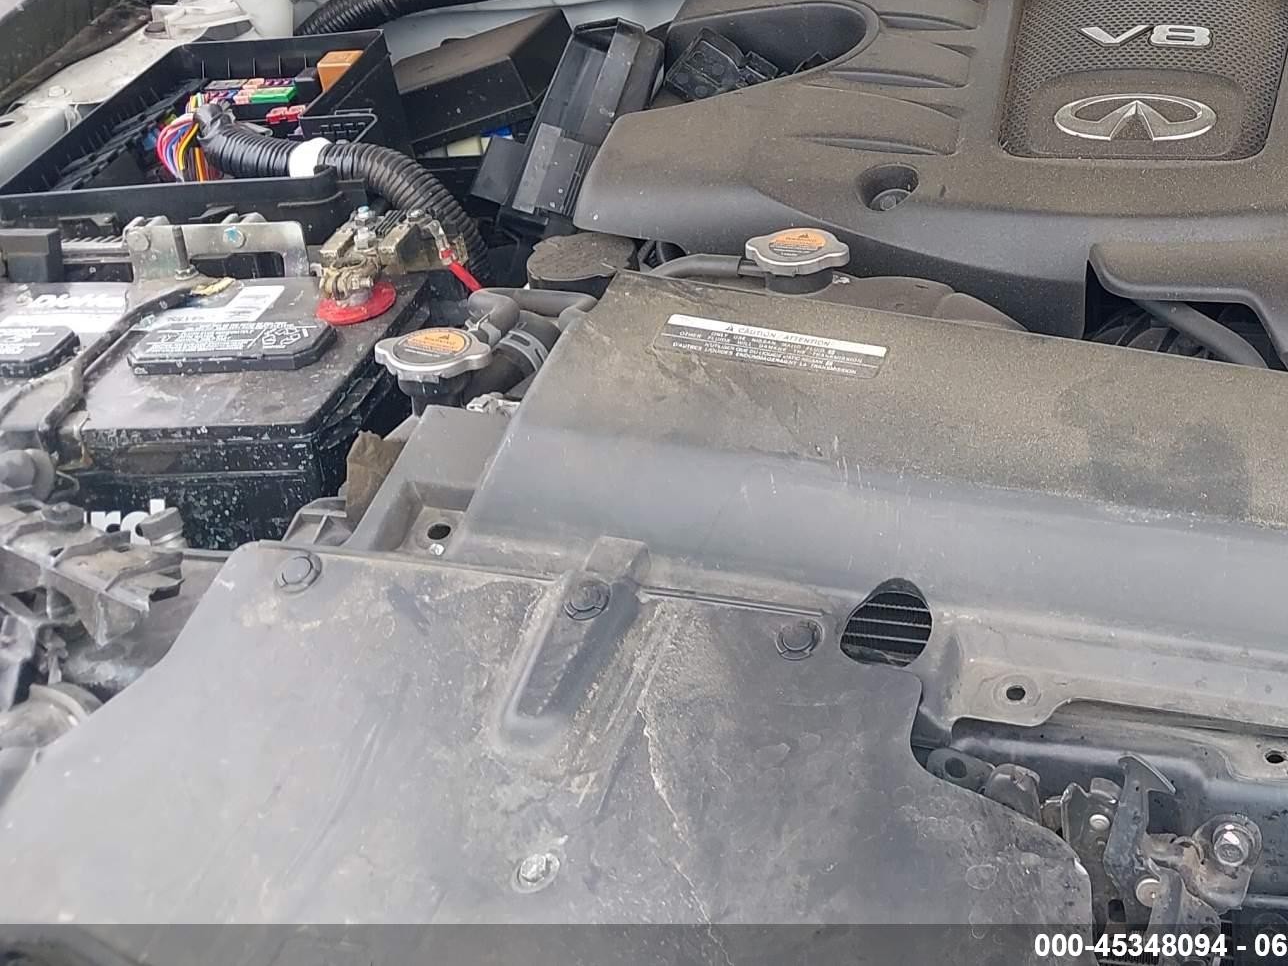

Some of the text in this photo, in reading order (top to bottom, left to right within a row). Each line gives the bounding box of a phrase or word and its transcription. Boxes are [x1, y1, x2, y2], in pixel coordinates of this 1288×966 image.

[1079, 24, 1214, 48] V8
[738, 327, 832, 347] CAUTION ATTENTION
